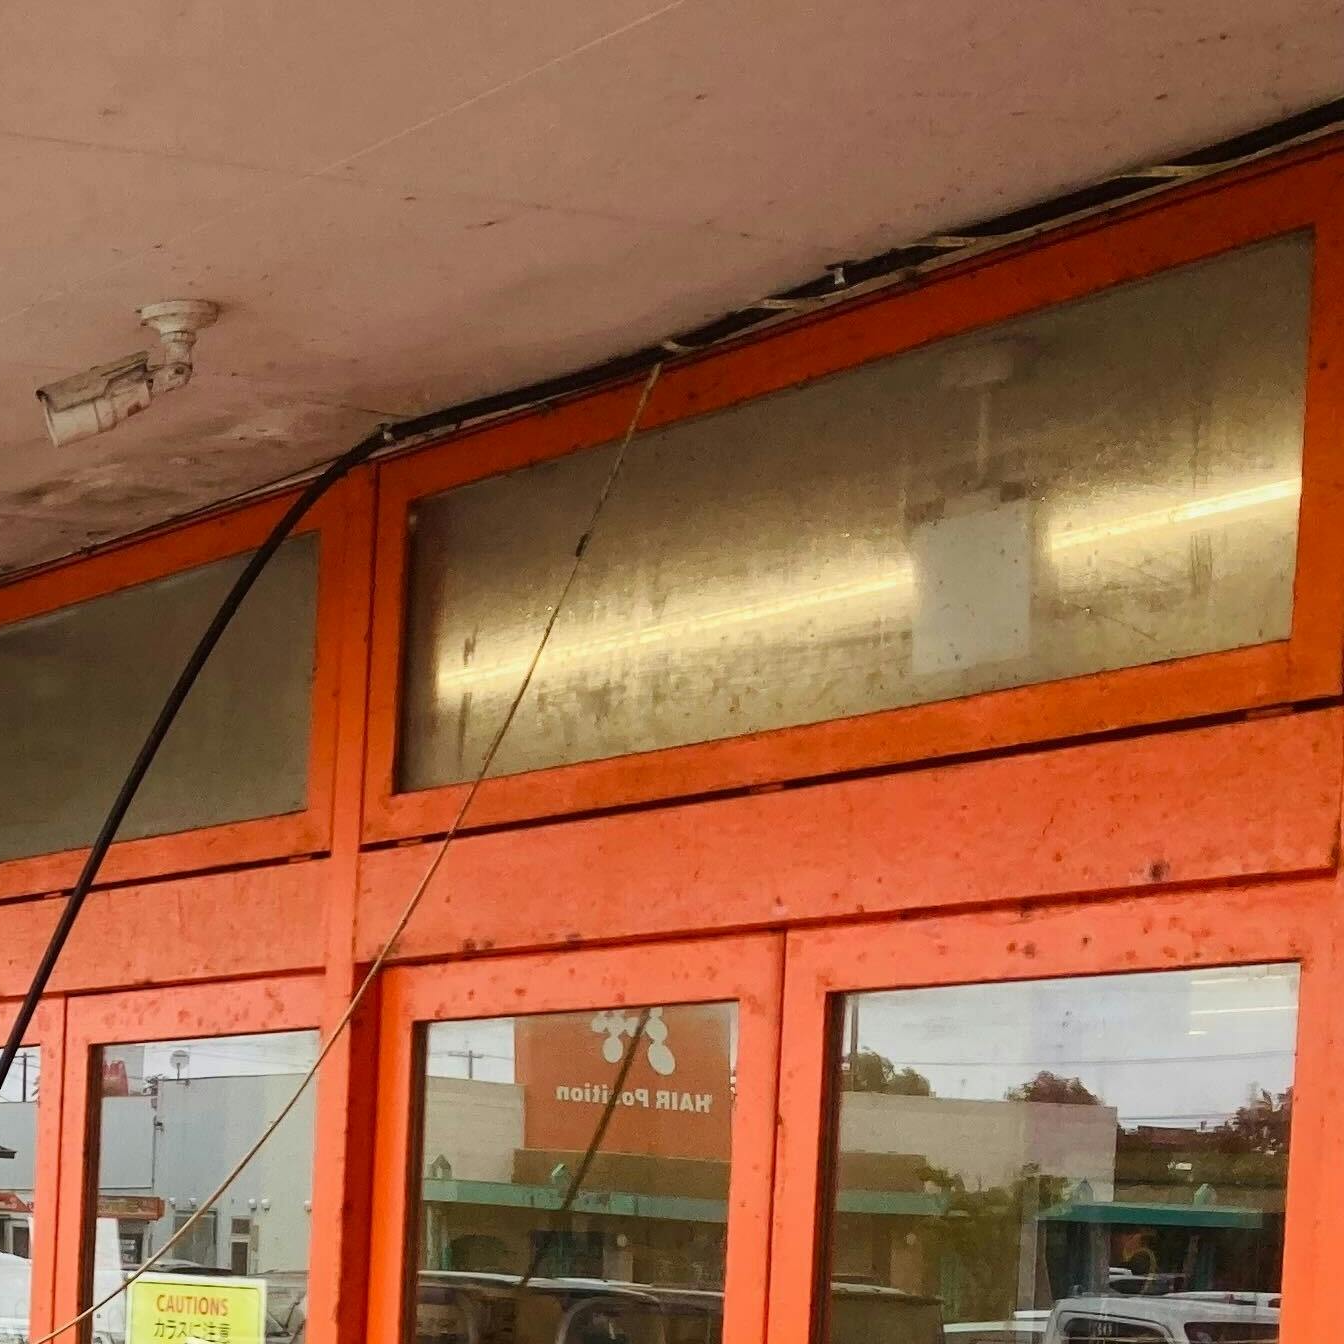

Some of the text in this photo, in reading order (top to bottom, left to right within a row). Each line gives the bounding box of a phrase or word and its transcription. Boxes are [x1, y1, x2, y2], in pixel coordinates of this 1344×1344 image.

[157, 1294, 229, 1317] CAUTIONS
[153, 1318, 231, 1344] カラスに注意
